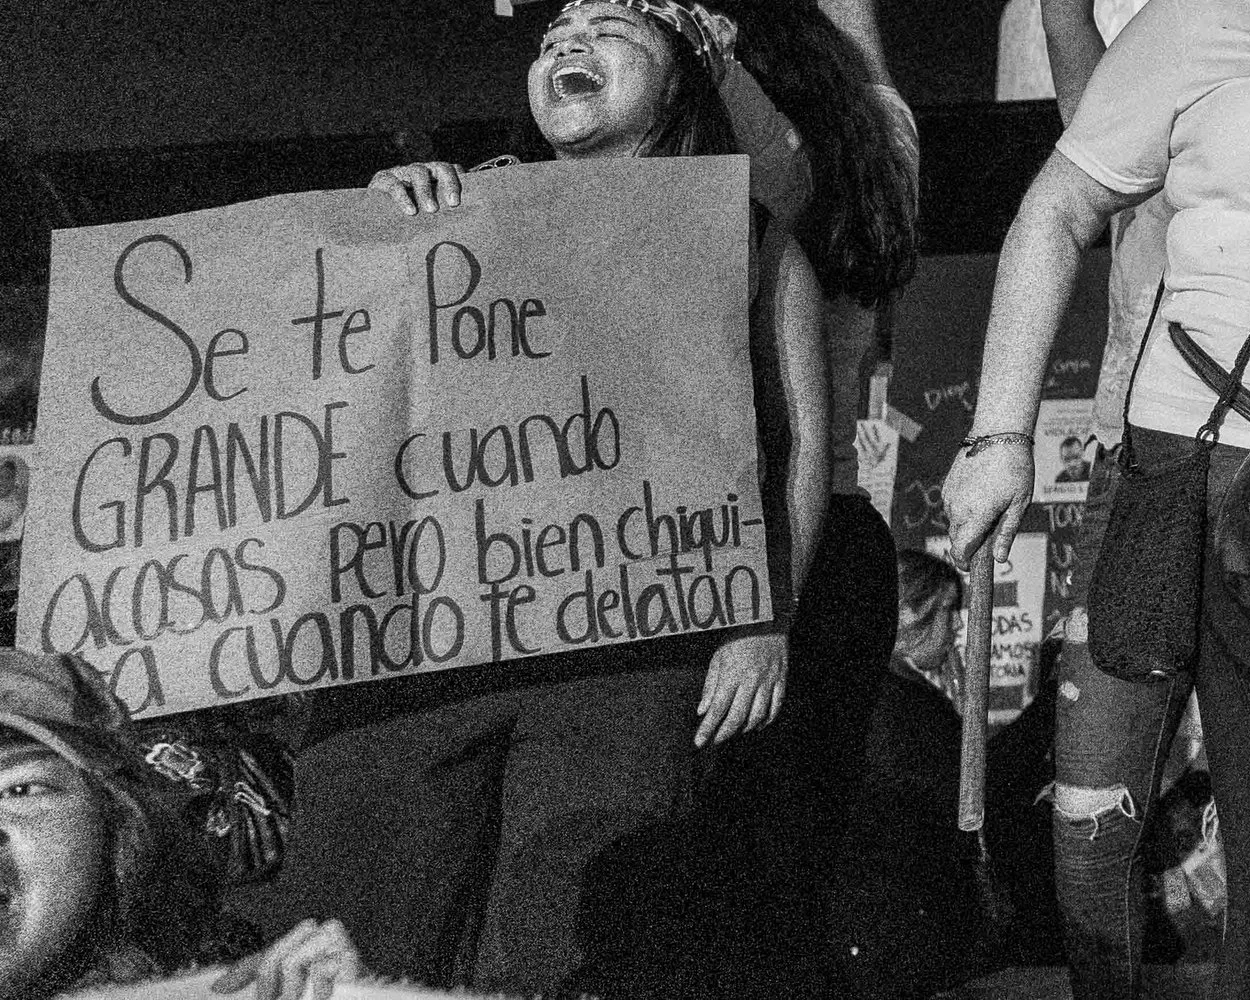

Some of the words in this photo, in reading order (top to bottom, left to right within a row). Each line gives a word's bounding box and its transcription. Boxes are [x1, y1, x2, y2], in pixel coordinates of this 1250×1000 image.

[91, 234, 249, 425] Se
[292, 248, 375, 380] te
[426, 241, 552, 364] Pone
[72, 401, 350, 553] GRANDE
[395, 375, 621, 500] cuando
[40, 538, 288, 658] acosas
[329, 515, 446, 604] pero
[476, 499, 604, 586] bien
[617, 480, 764, 573] chiqui-
[103, 647, 166, 714] a
[209, 587, 464, 700] cuando
[484, 580, 541, 662] te
[556, 553, 762, 644] delatan
